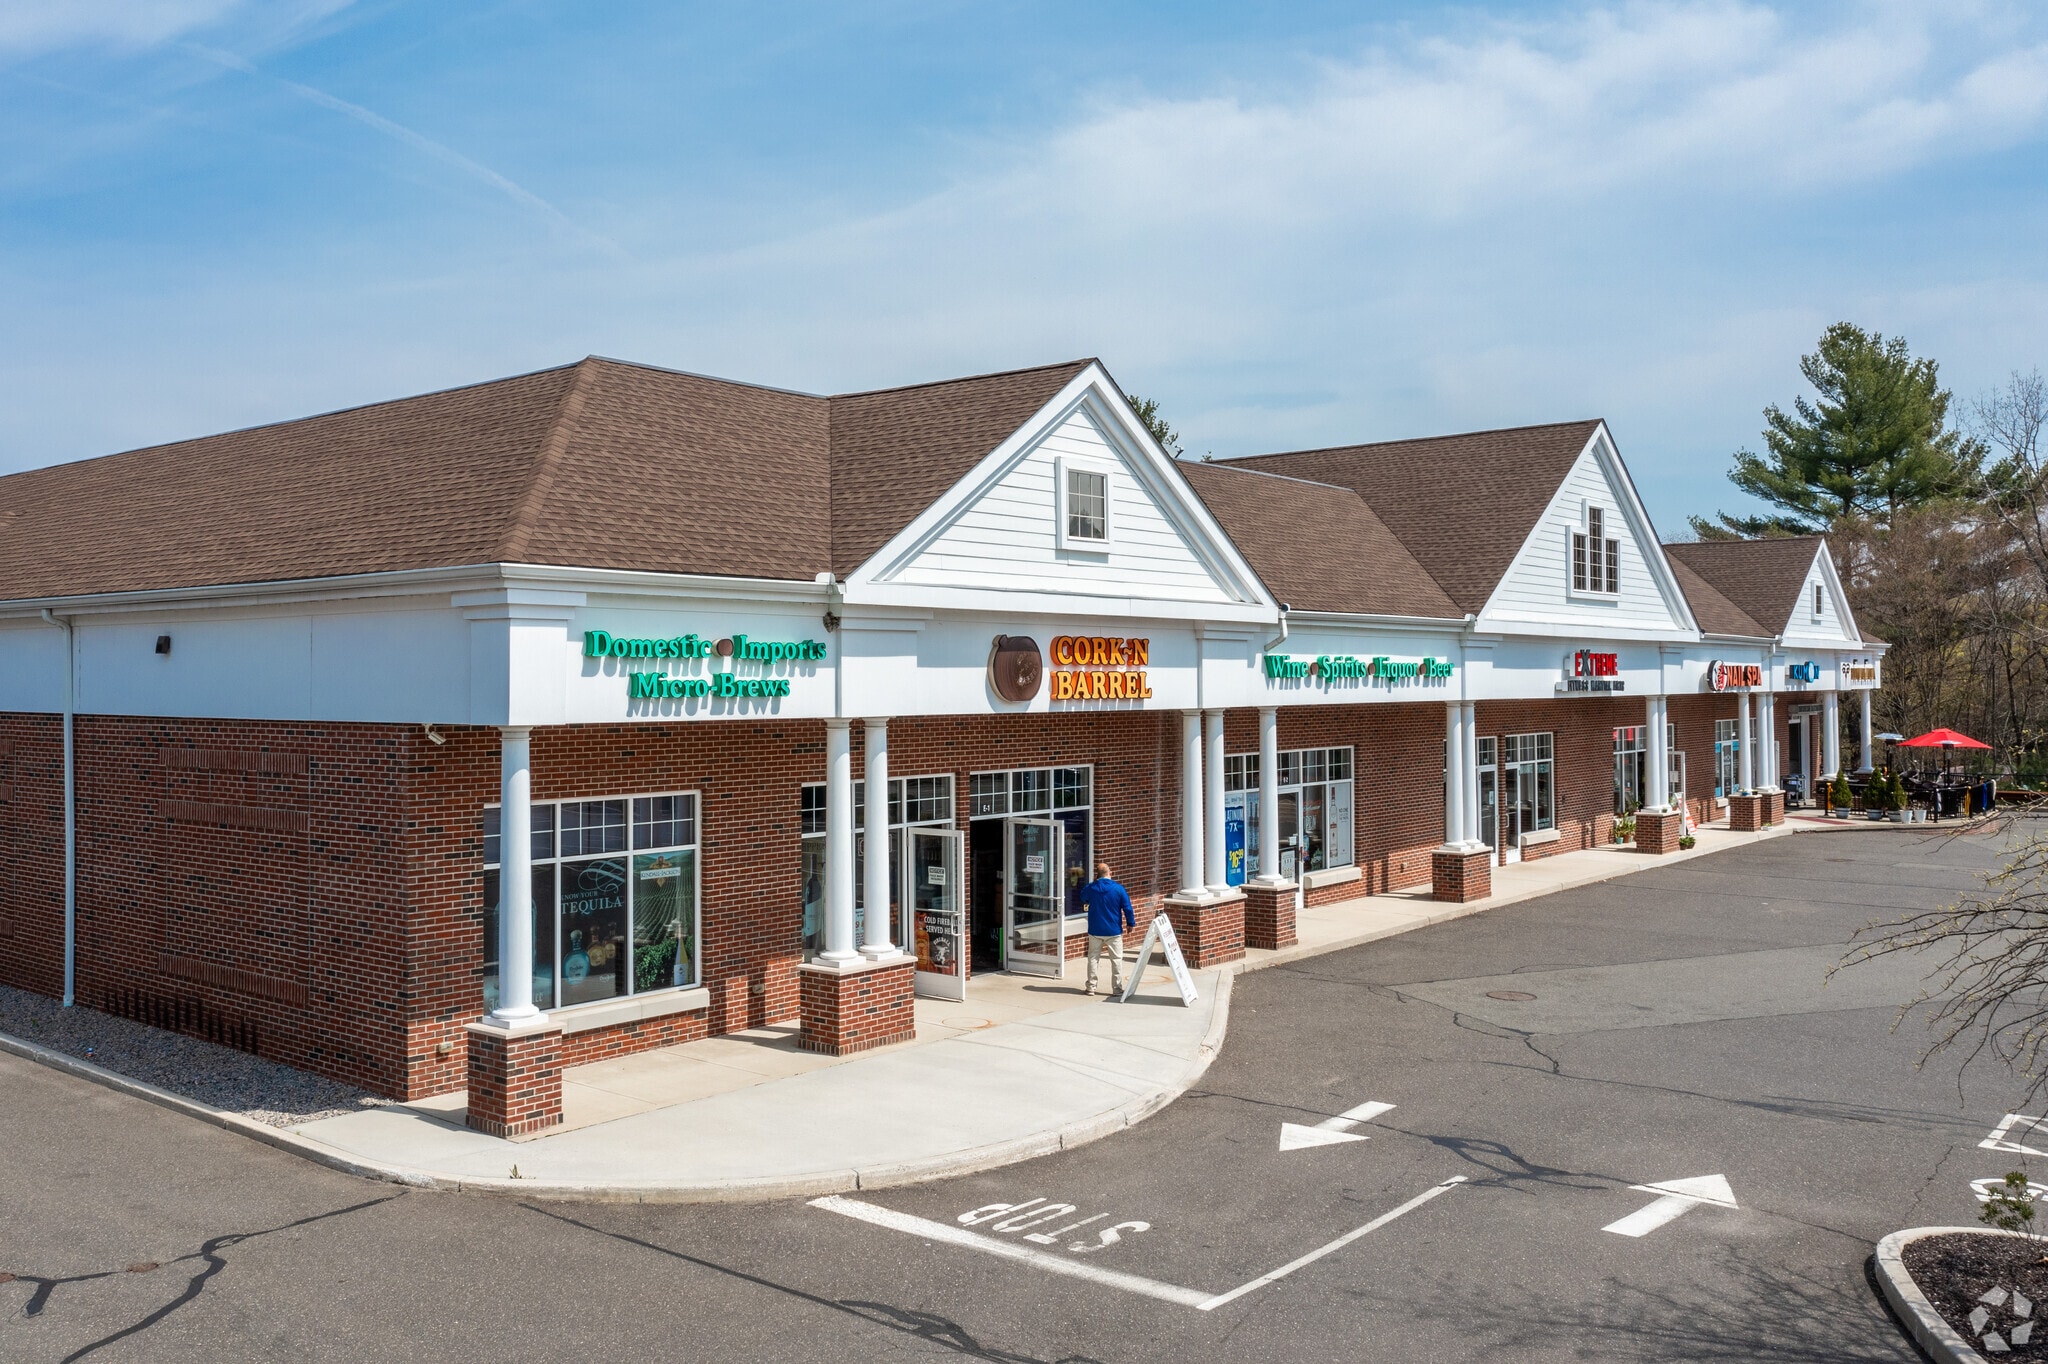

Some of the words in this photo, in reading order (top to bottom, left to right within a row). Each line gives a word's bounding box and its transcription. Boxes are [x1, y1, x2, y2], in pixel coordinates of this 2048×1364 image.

[585, 630, 712, 658] Domestic
[733, 634, 827, 664] Imports
[1265, 655, 1308, 678] Wine
[1318, 655, 1366, 682] Spirits
[1374, 657, 1418, 682] Liquor
[1424, 657, 1454, 678] Beer
[1574, 649, 1618, 676] EXTREME
[1789, 661, 1820, 683] KUMON
[630, 672, 790, 698] Micro-Brews
[1051, 670, 1152, 700] BARREL
[1726, 665, 1745, 687] NAIL
[1746, 665, 1762, 687] SPA
[561, 896, 622, 915] TEQUILA
[923, 916, 937, 925] COLD
[925, 925, 943, 934] SERVED
[957, 1198, 1150, 1252] STOP
